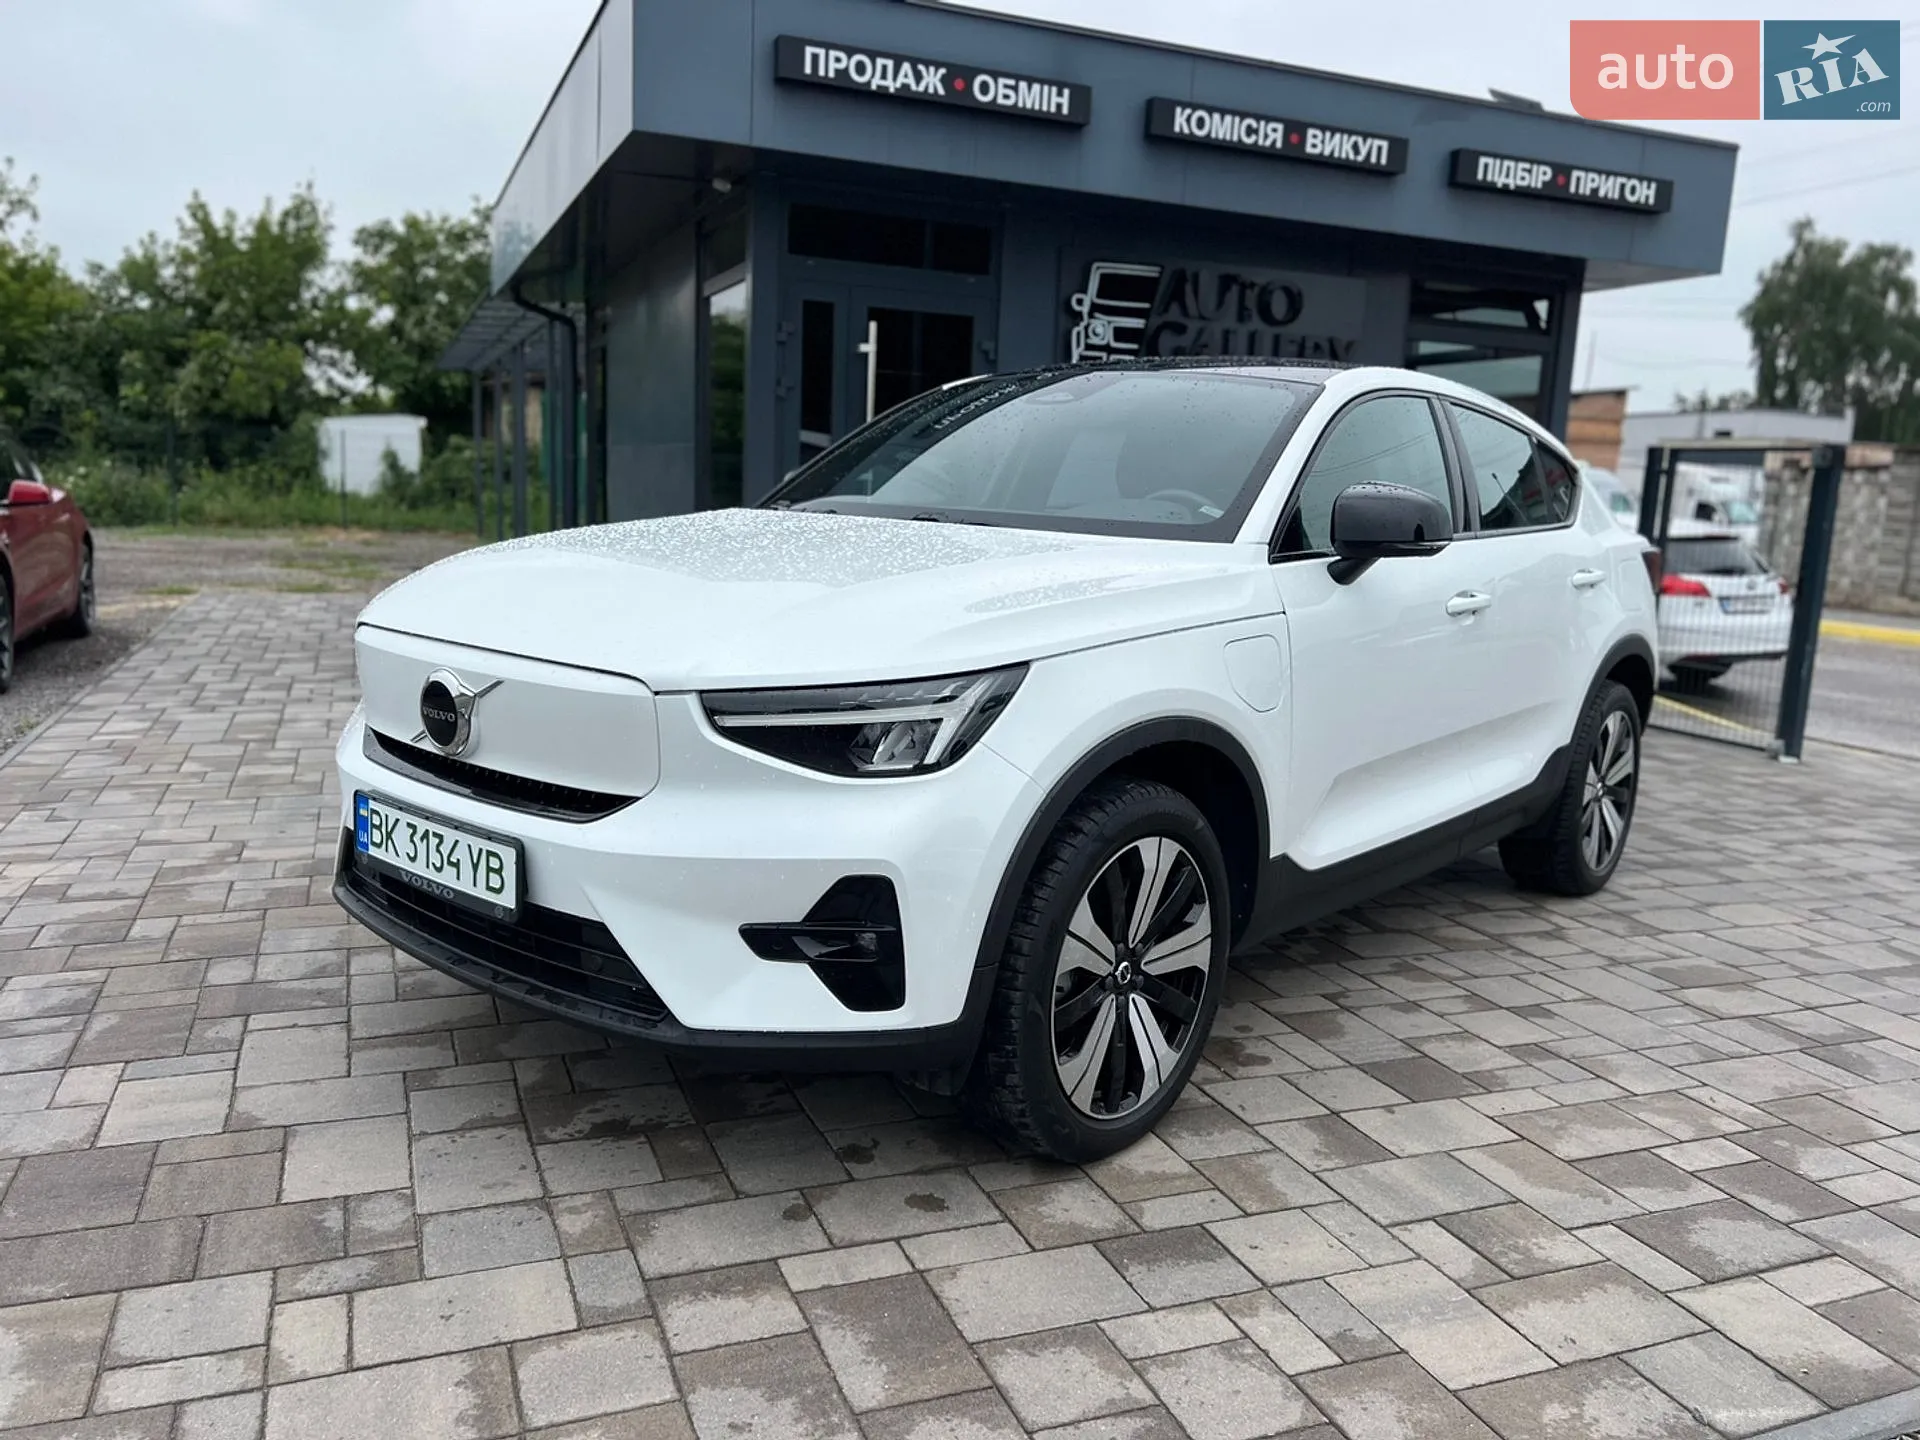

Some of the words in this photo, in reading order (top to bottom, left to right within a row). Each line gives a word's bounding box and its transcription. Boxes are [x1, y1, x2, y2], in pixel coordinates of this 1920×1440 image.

[803, 45, 947, 96] ПРОДАЖ
[972, 73, 1070, 116] ОБМІН
[1173, 105, 1285, 149] КОМІСІЯ
[1304, 127, 1389, 166] ВИКУП
[1476, 155, 1553, 191] ПІДБІР
[1569, 169, 1658, 206] ПРИГОН
[1152, 267, 1304, 328] AUTO
[422, 705, 456, 722] VOLVO
[358, 831, 368, 844] UA
[369, 807, 401, 859] BK
[406, 821, 461, 882] 3134
[467, 842, 506, 896] YB
[400, 869, 455, 900] VOLVO
